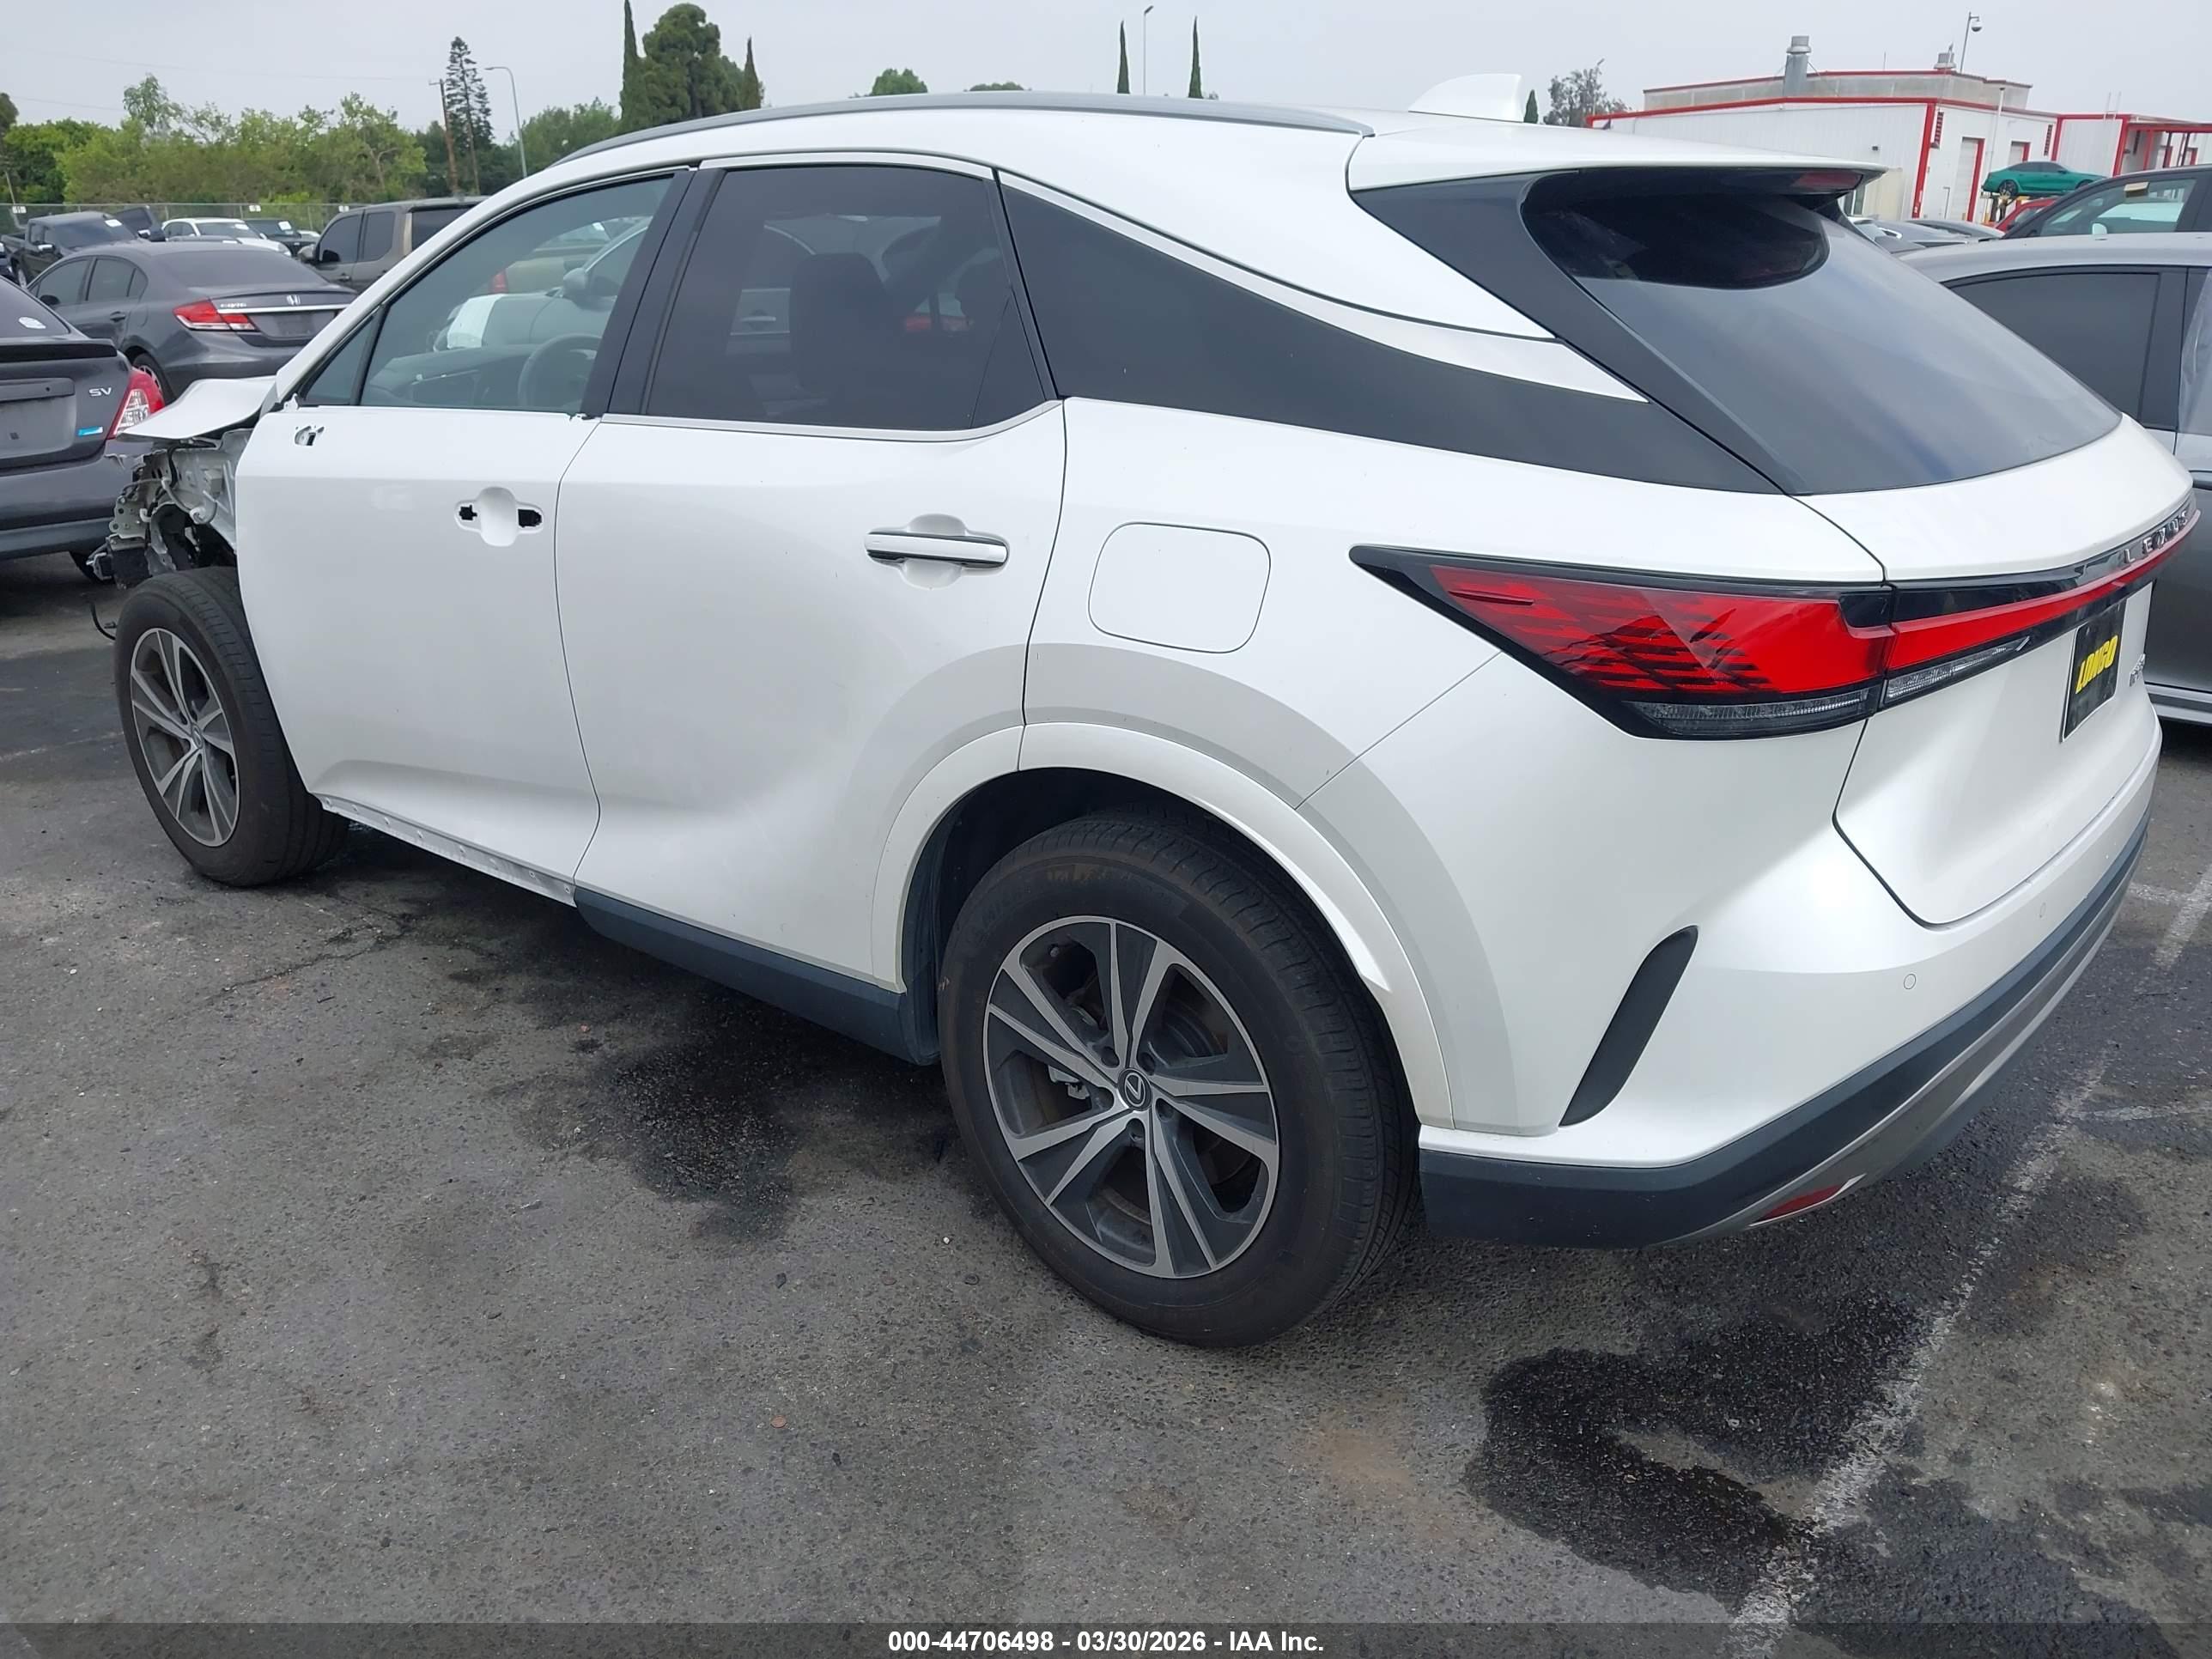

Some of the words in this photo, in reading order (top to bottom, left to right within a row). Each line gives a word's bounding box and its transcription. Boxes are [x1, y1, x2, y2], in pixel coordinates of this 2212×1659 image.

[88, 387, 112, 397] SV
[2124, 510, 2188, 563] LEXUS
[2075, 635, 2118, 695] LONGO
